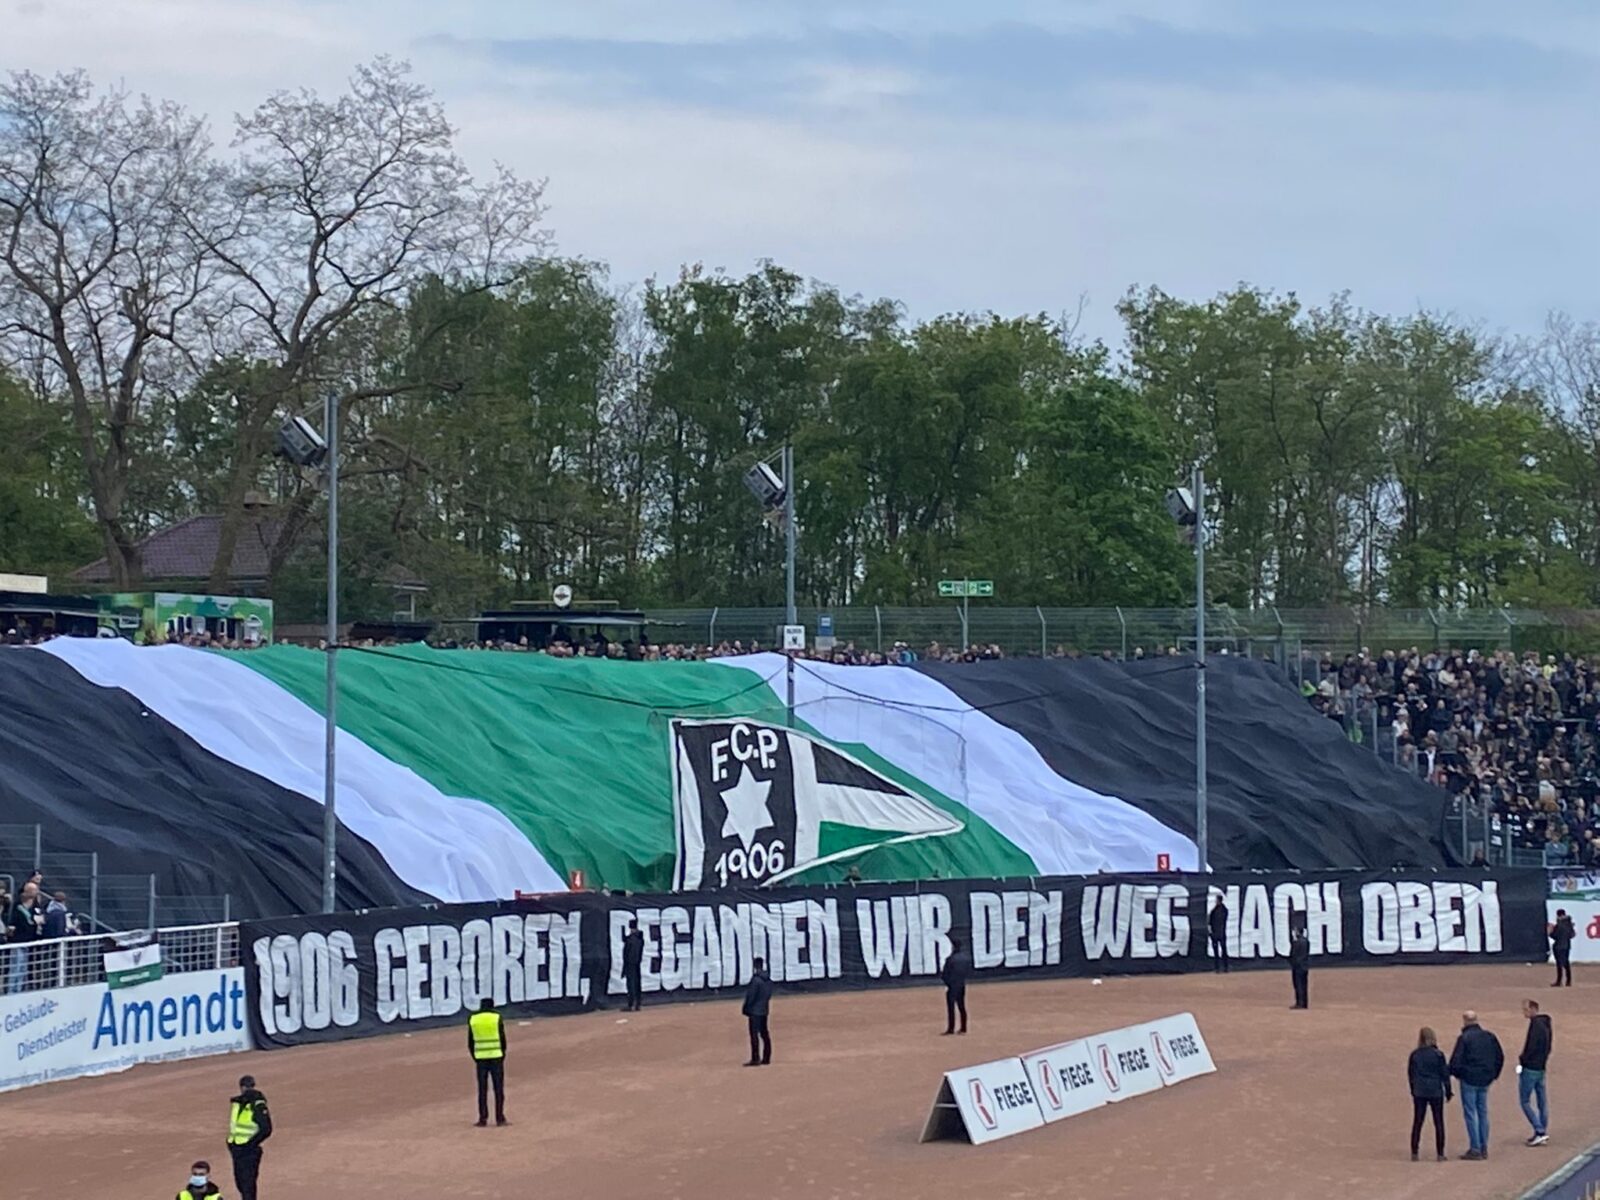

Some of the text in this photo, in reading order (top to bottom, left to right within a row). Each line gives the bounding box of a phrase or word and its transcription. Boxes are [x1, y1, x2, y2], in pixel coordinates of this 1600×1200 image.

[715, 840, 784, 887] 1906
[253, 930, 359, 1035] 1906
[374, 911, 590, 1022] GEBOREN,
[855, 893, 952, 978] WIR
[970, 891, 1062, 968] DEN
[1081, 884, 1190, 959] WEG
[1361, 881, 1502, 954] OBEN
[93, 974, 243, 1050] Amendt
[18, 1017, 87, 1060] Dienstleister
[1169, 1034, 1199, 1060] FIEGE
[1059, 1062, 1094, 1092] FIEGE
[1117, 1047, 1150, 1076] FIEGE
[993, 1081, 1033, 1111] FIEGE
